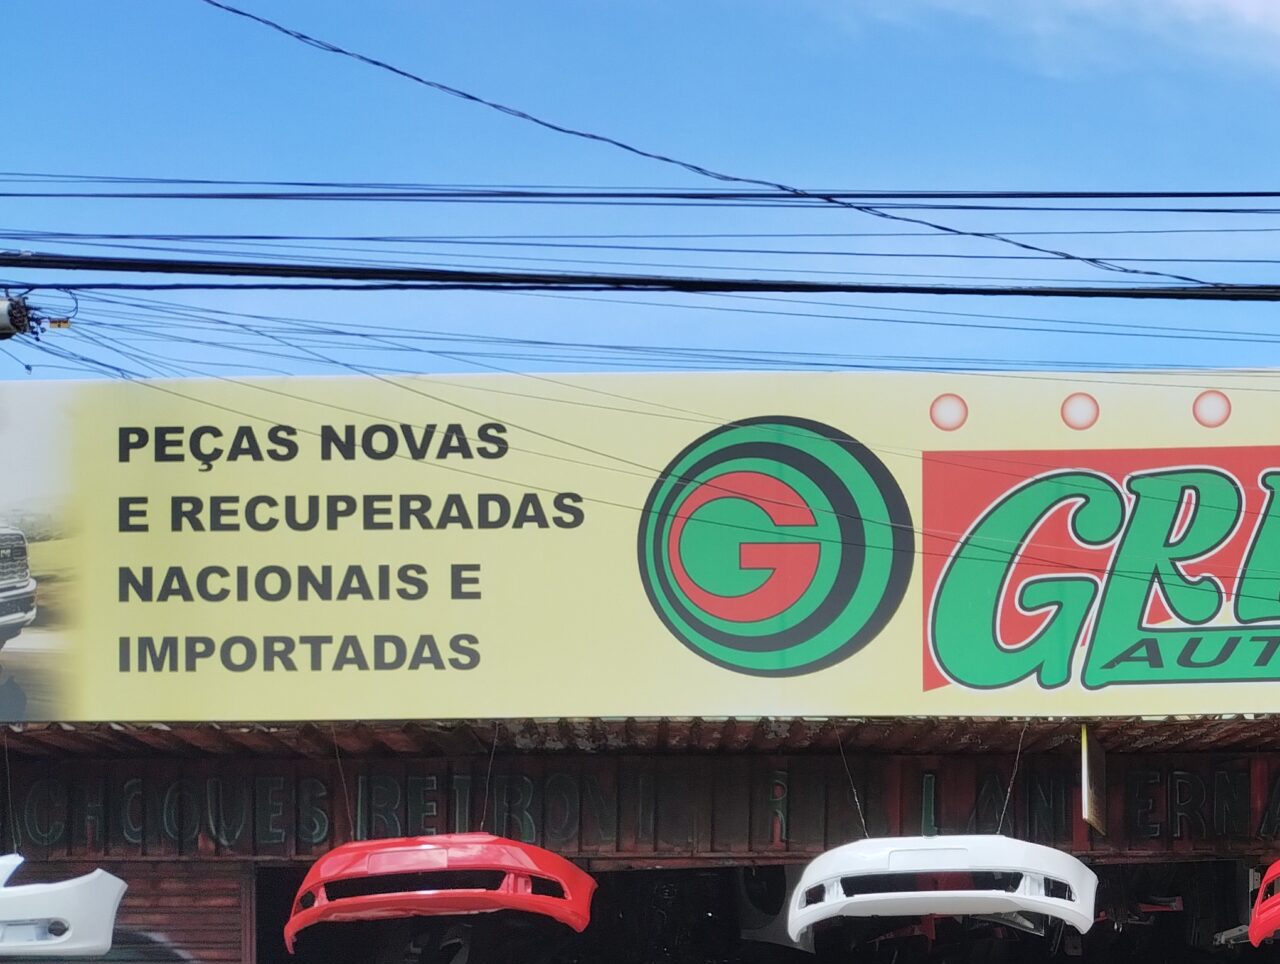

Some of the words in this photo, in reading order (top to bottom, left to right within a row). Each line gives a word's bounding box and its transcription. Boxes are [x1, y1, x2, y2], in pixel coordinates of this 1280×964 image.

[118, 424, 299, 473] PEÇAS
[320, 422, 509, 461] NOVAS
[118, 496, 150, 533] E
[170, 492, 585, 533] RECUPERADAS
[118, 563, 429, 603] NACIONAIS
[450, 563, 482, 600] E
[118, 633, 481, 673] IMPORTADAS
